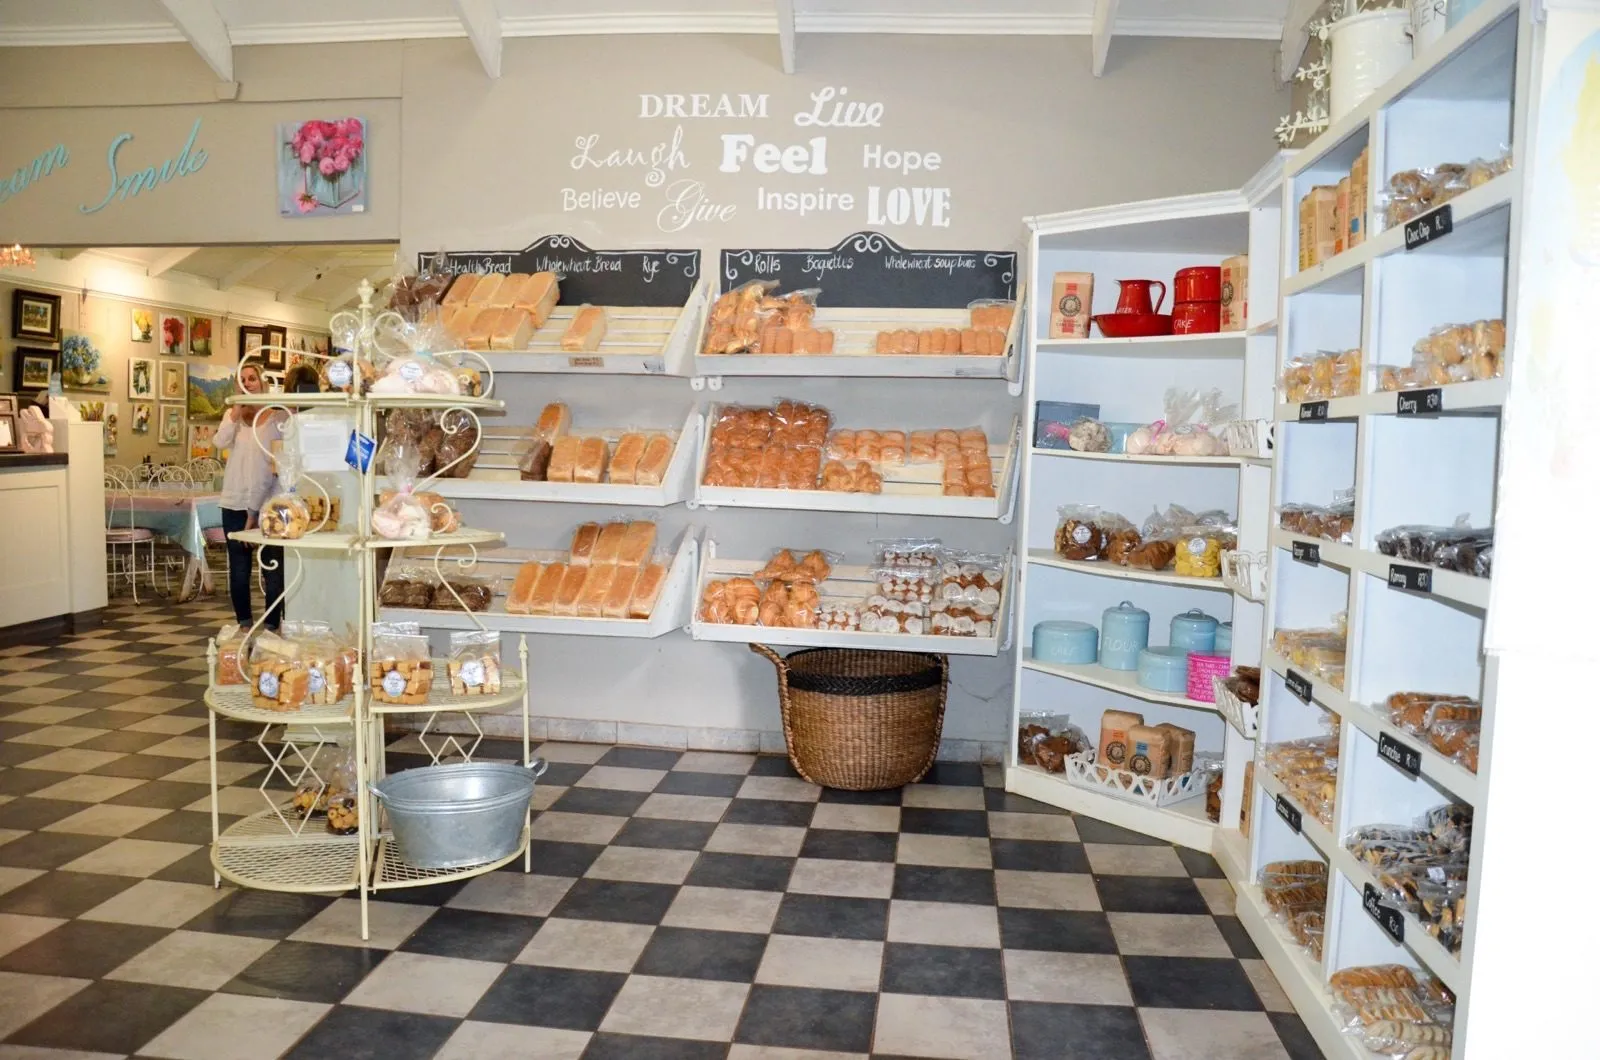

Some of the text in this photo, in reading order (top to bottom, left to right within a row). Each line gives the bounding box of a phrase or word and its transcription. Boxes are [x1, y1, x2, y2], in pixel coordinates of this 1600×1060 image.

[638, 86, 885, 128] DREAM Live
[570, 125, 942, 187] Laugh Feel Hope
[560, 179, 952, 233] Believe Give Inspire LOVE
[482, 257, 512, 276] Bread
[592, 255, 622, 273] Bread
[642, 255, 661, 283] Rye
[755, 254, 781, 274] Rolls
[1173, 319, 1195, 330] CAKE
[1400, 396, 1417, 414] Cherry
